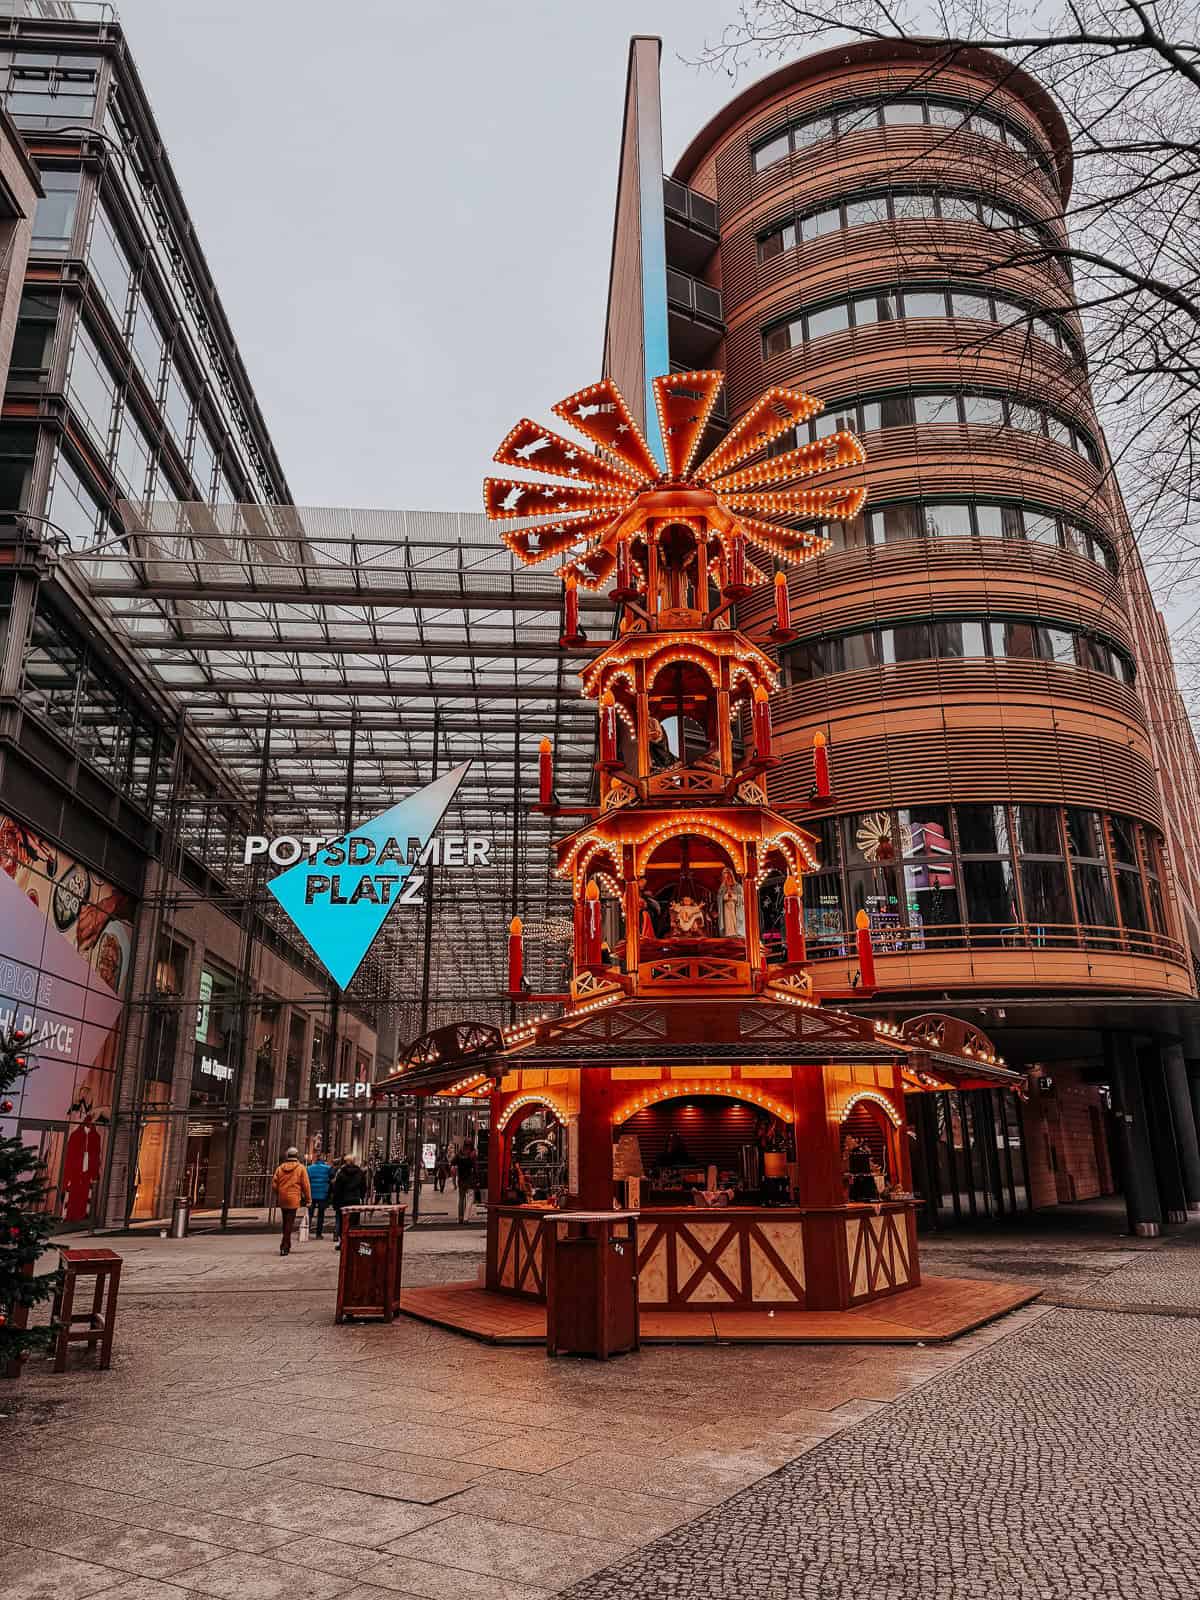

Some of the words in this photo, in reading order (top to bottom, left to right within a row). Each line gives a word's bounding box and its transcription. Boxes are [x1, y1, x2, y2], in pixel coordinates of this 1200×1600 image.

[243, 835, 492, 867] POTSDAMER
[304, 874, 426, 906] PLATZ
[315, 1082, 351, 1099] THE
